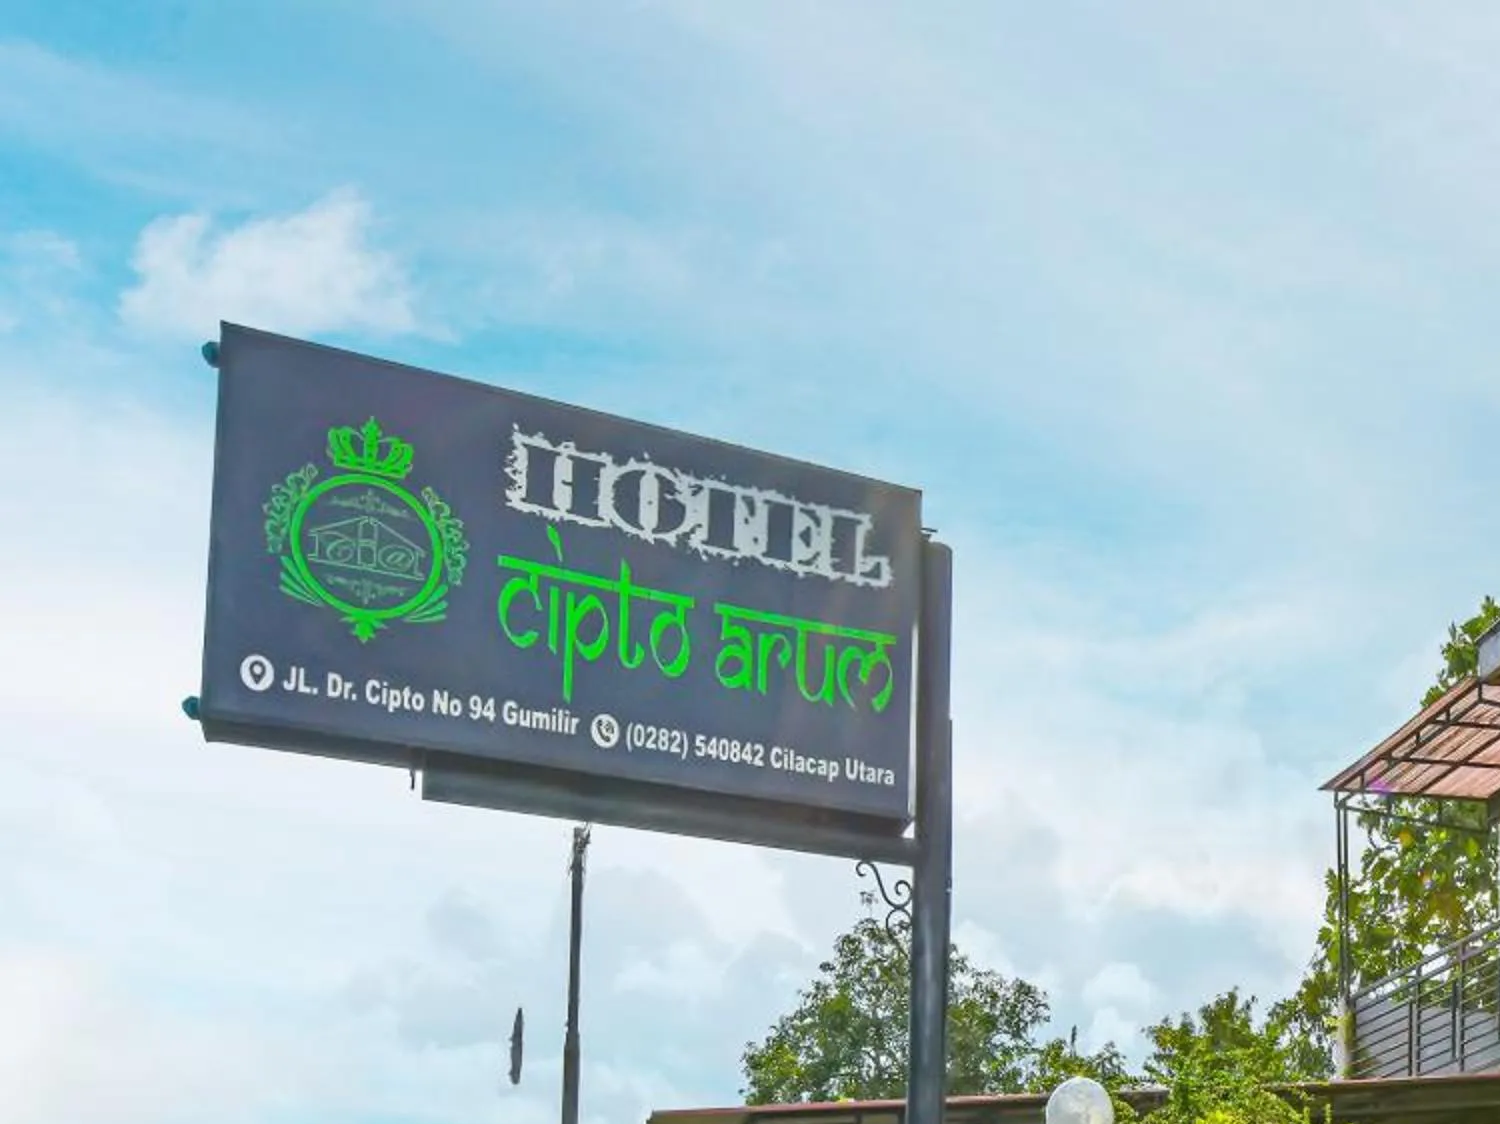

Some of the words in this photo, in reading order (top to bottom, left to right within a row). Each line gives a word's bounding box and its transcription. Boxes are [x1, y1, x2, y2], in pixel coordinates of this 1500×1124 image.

[504, 423, 895, 588] HOTEL
[497, 524, 695, 704] cipto
[713, 602, 897, 713] arum
[283, 666, 318, 694] JL.
[327, 672, 357, 700] Dr.
[365, 679, 425, 712] Cipto
[432, 689, 462, 717] No
[469, 695, 496, 722] 94
[502, 701, 580, 735] Gumilir
[626, 722, 688, 759] (0282)
[695, 734, 765, 768] 540842
[770, 747, 839, 782] Cilacap
[845, 758, 895, 786] Utara
